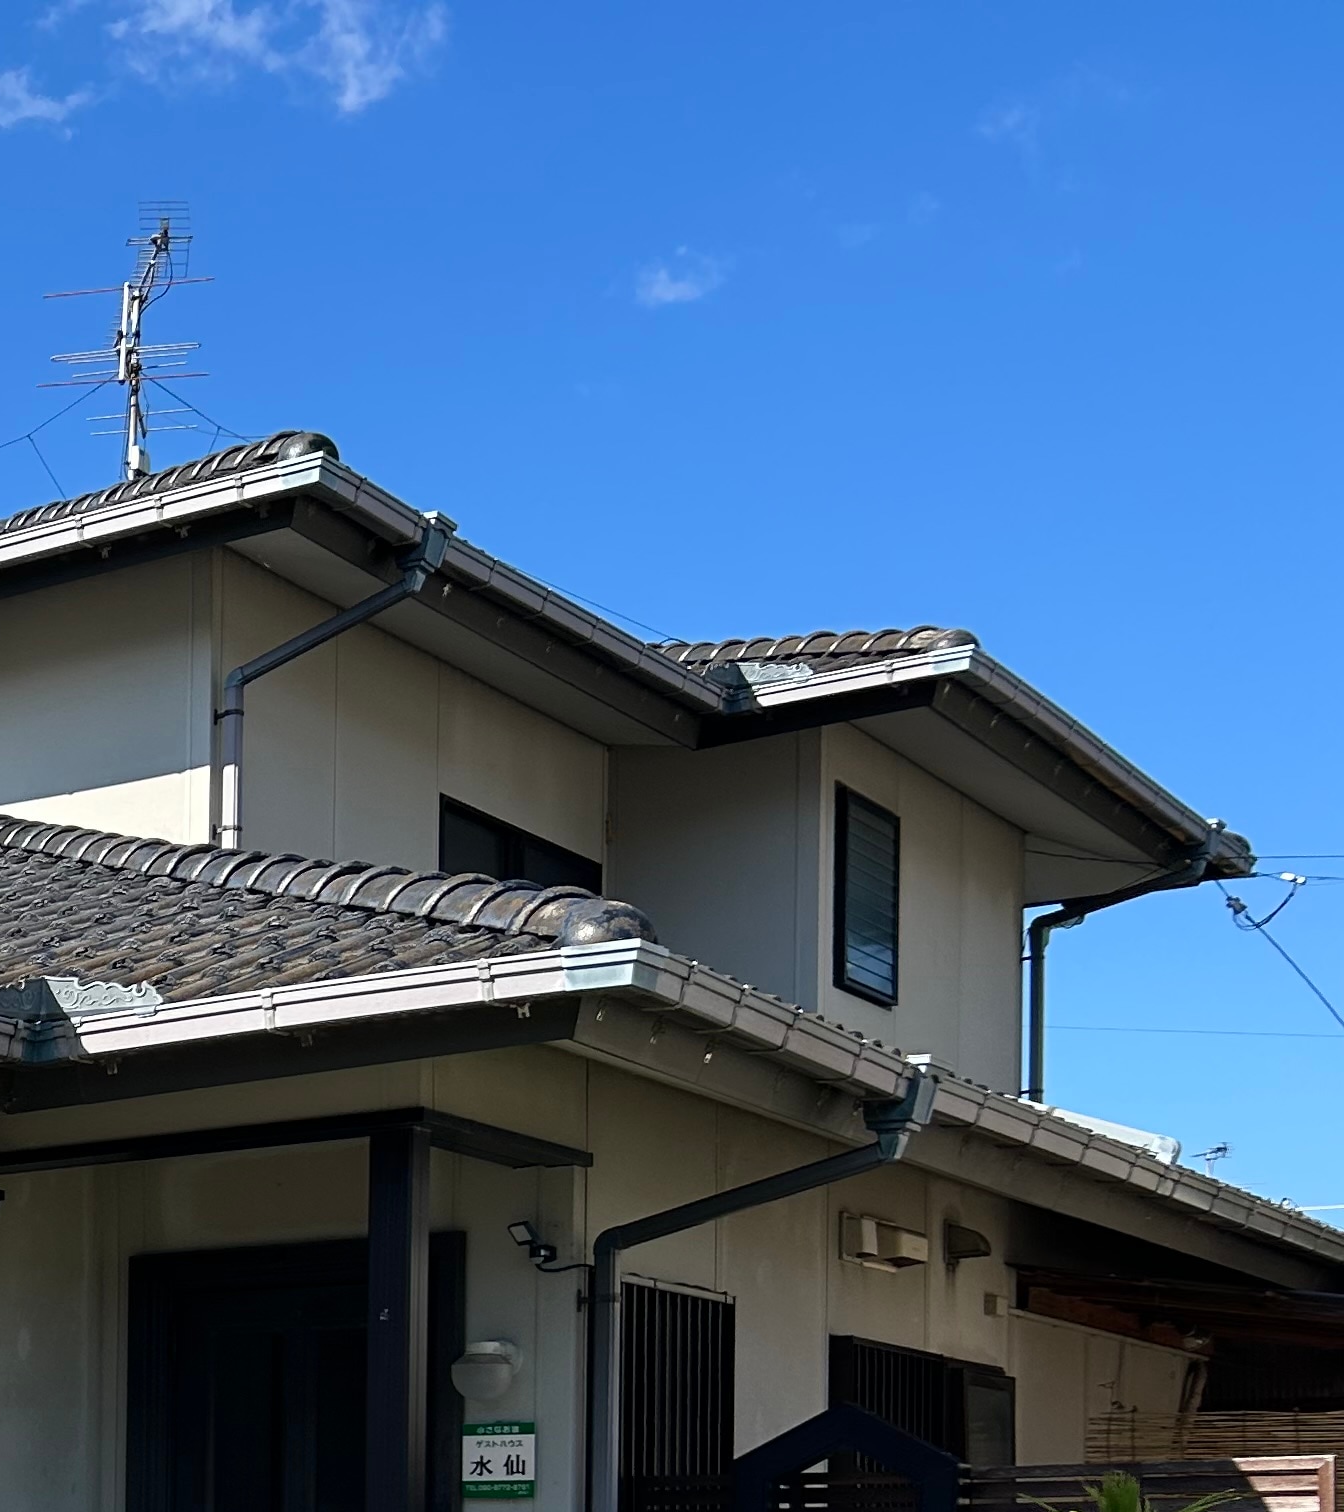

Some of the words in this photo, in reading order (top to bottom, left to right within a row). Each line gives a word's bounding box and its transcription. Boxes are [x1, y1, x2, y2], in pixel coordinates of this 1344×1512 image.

[476, 1440, 524, 1448] ゲストハウス
[469, 1454, 526, 1476] 水仙
